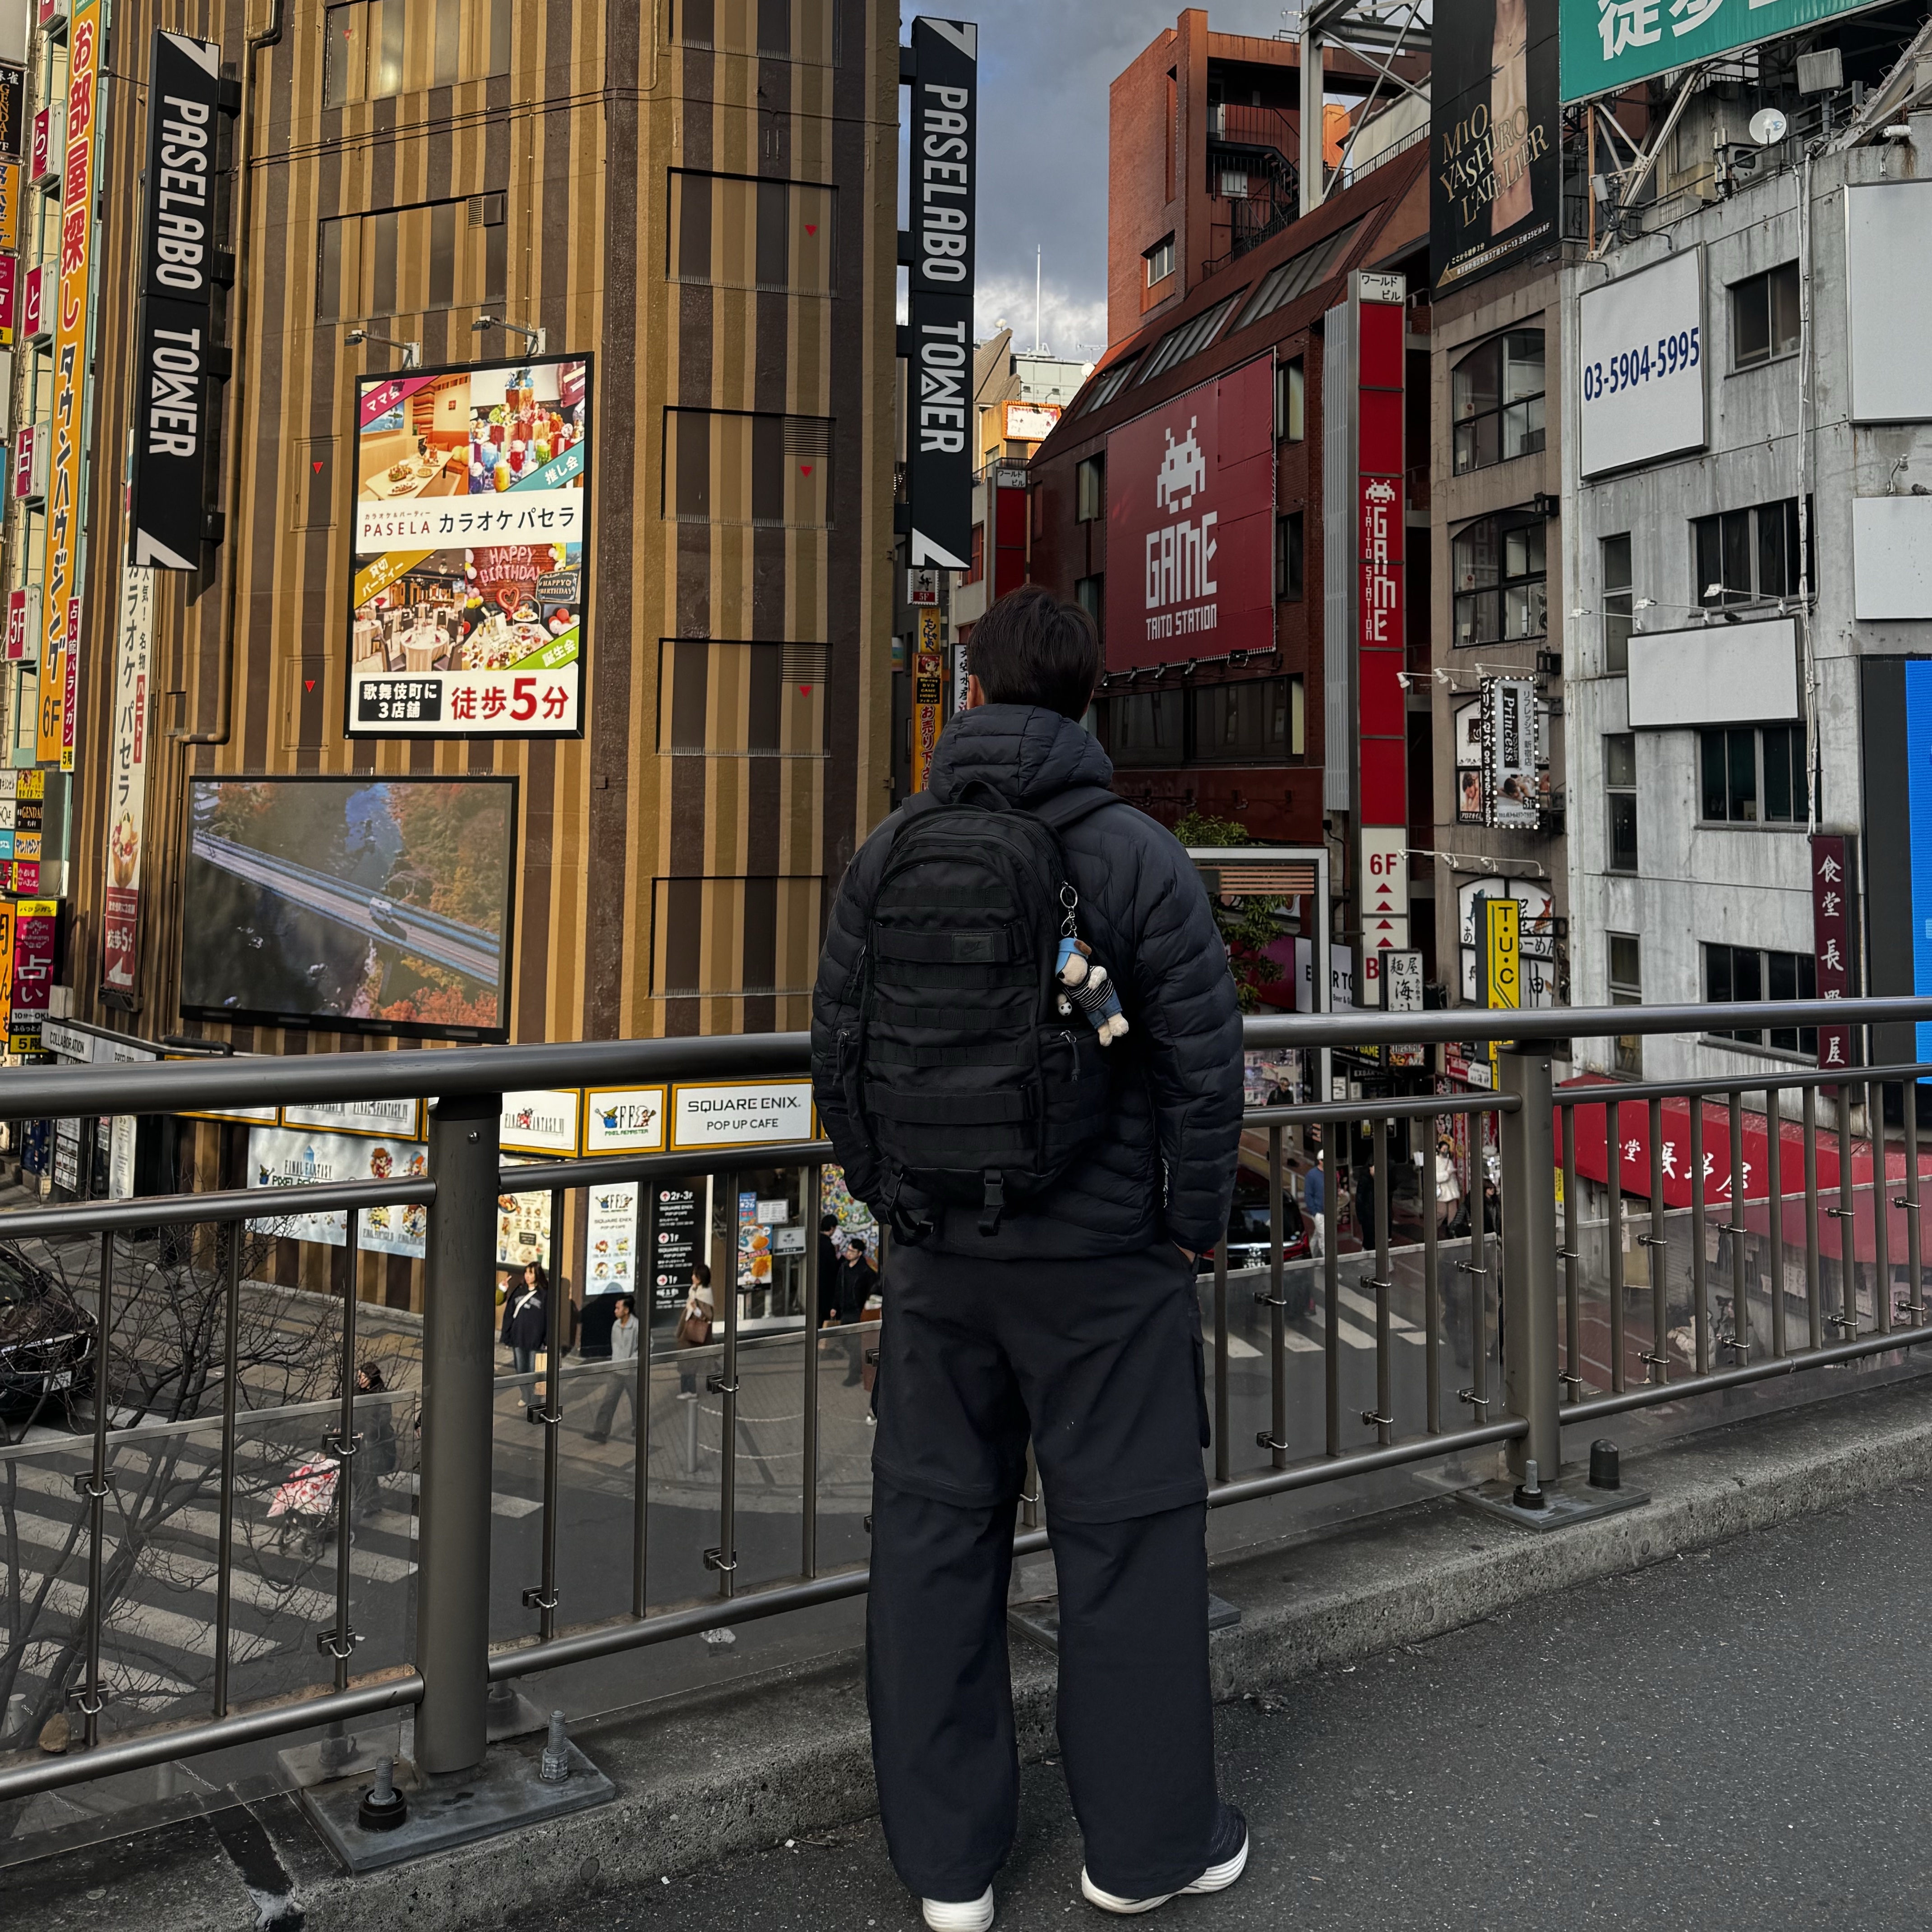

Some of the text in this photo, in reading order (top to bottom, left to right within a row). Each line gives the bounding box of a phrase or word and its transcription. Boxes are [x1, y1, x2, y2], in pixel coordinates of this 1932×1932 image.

[1442, 103, 1488, 165] MIO
[1439, 106, 1529, 204] YASHIRO
[60, 19, 94, 331] お部屋探し
[1461, 124, 1549, 228] L'ATELIER
[149, 95, 209, 457] PASELABO TOWER
[921, 83, 968, 453] PASELABO TOWER
[1361, 274, 1398, 288] ワールド
[1381, 288, 1401, 302] ビル
[1584, 327, 1700, 402] 03-5904-5995
[544, 455, 579, 486] 推し会
[997, 469, 1024, 478] ワールド
[1012, 479, 1025, 487] ビル
[46, 341, 77, 684] タウンハウジング
[364, 507, 575, 537] PASELA カラオケ パセラ
[480, 564, 545, 586] BIRTHDAY
[489, 546, 536, 566] HAPPY
[1146, 511, 1217, 610] GAME
[1374, 507, 1396, 641] GAME
[362, 562, 404, 597] パーティー
[919, 593, 929, 601] 5F
[10, 607, 25, 645] 5F
[1146, 603, 1217, 641] TAITO STATION
[65, 603, 78, 743] 占い館バランガン
[364, 683, 437, 700] 歌舞伎町に
[43, 695, 62, 738] 6F
[378, 701, 420, 718] 3店舗
[451, 677, 569, 721] 徒歩5分
[1481, 680, 1491, 747] プリンセス
[136, 681, 144, 758] ハニトー
[1504, 696, 1515, 762] Princess
[118, 700, 134, 806] パセラ
[1369, 853, 1397, 875] 6F
[18, 954, 52, 1003] 占い
[50, 1031, 84, 1054] COLLABORATION
[687, 1098, 758, 1113] SQUARE
[706, 1118, 779, 1131] POP UP CAFE
[670, 1233, 679, 1242] 1F
[668, 1275, 678, 1284] 1F
